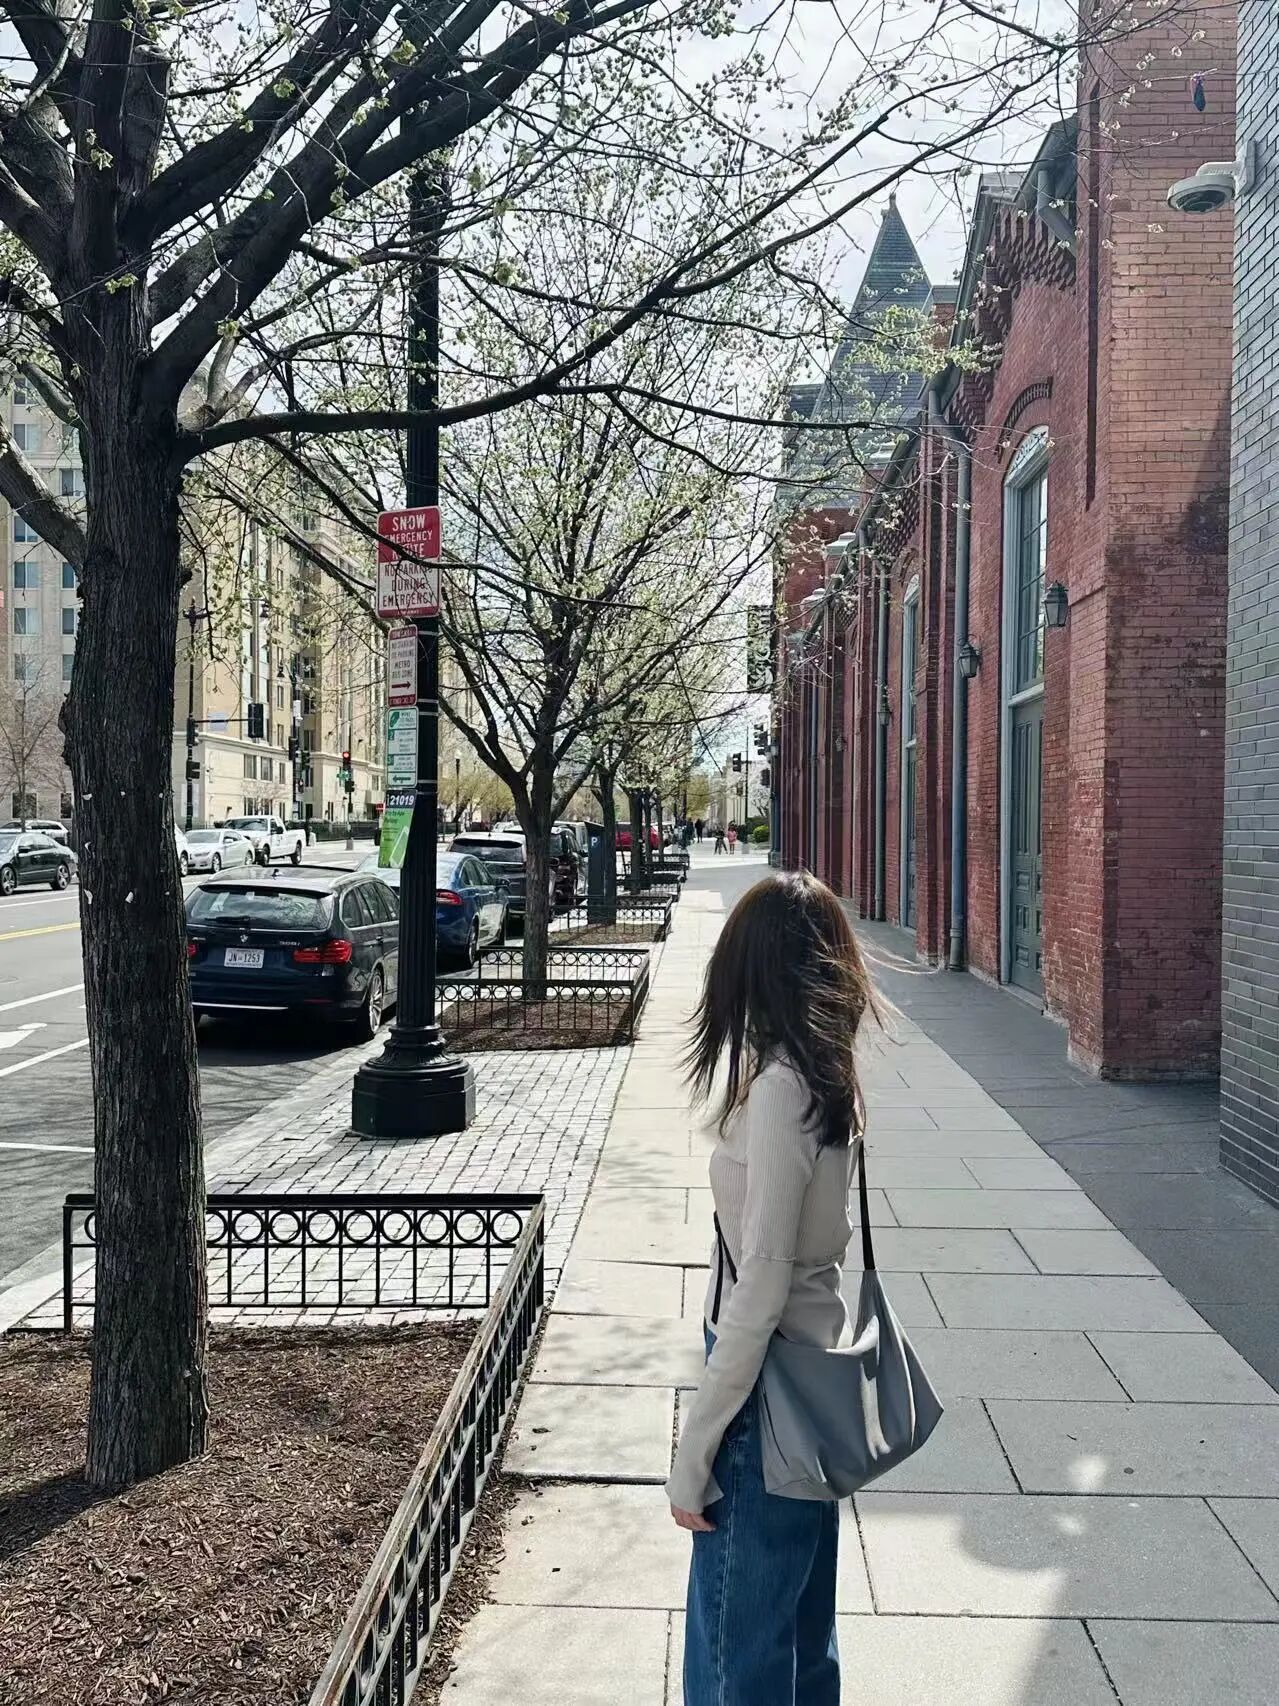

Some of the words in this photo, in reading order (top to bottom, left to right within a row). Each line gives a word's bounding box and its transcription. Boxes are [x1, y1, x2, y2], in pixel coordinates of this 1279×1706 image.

[392, 514, 426, 532] SNOW
[392, 543, 425, 560] UTE
[391, 578, 426, 592] DURING
[382, 592, 433, 607] EMERGENCY
[389, 795, 415, 806] 21019
[243, 953, 261, 963] 1253
